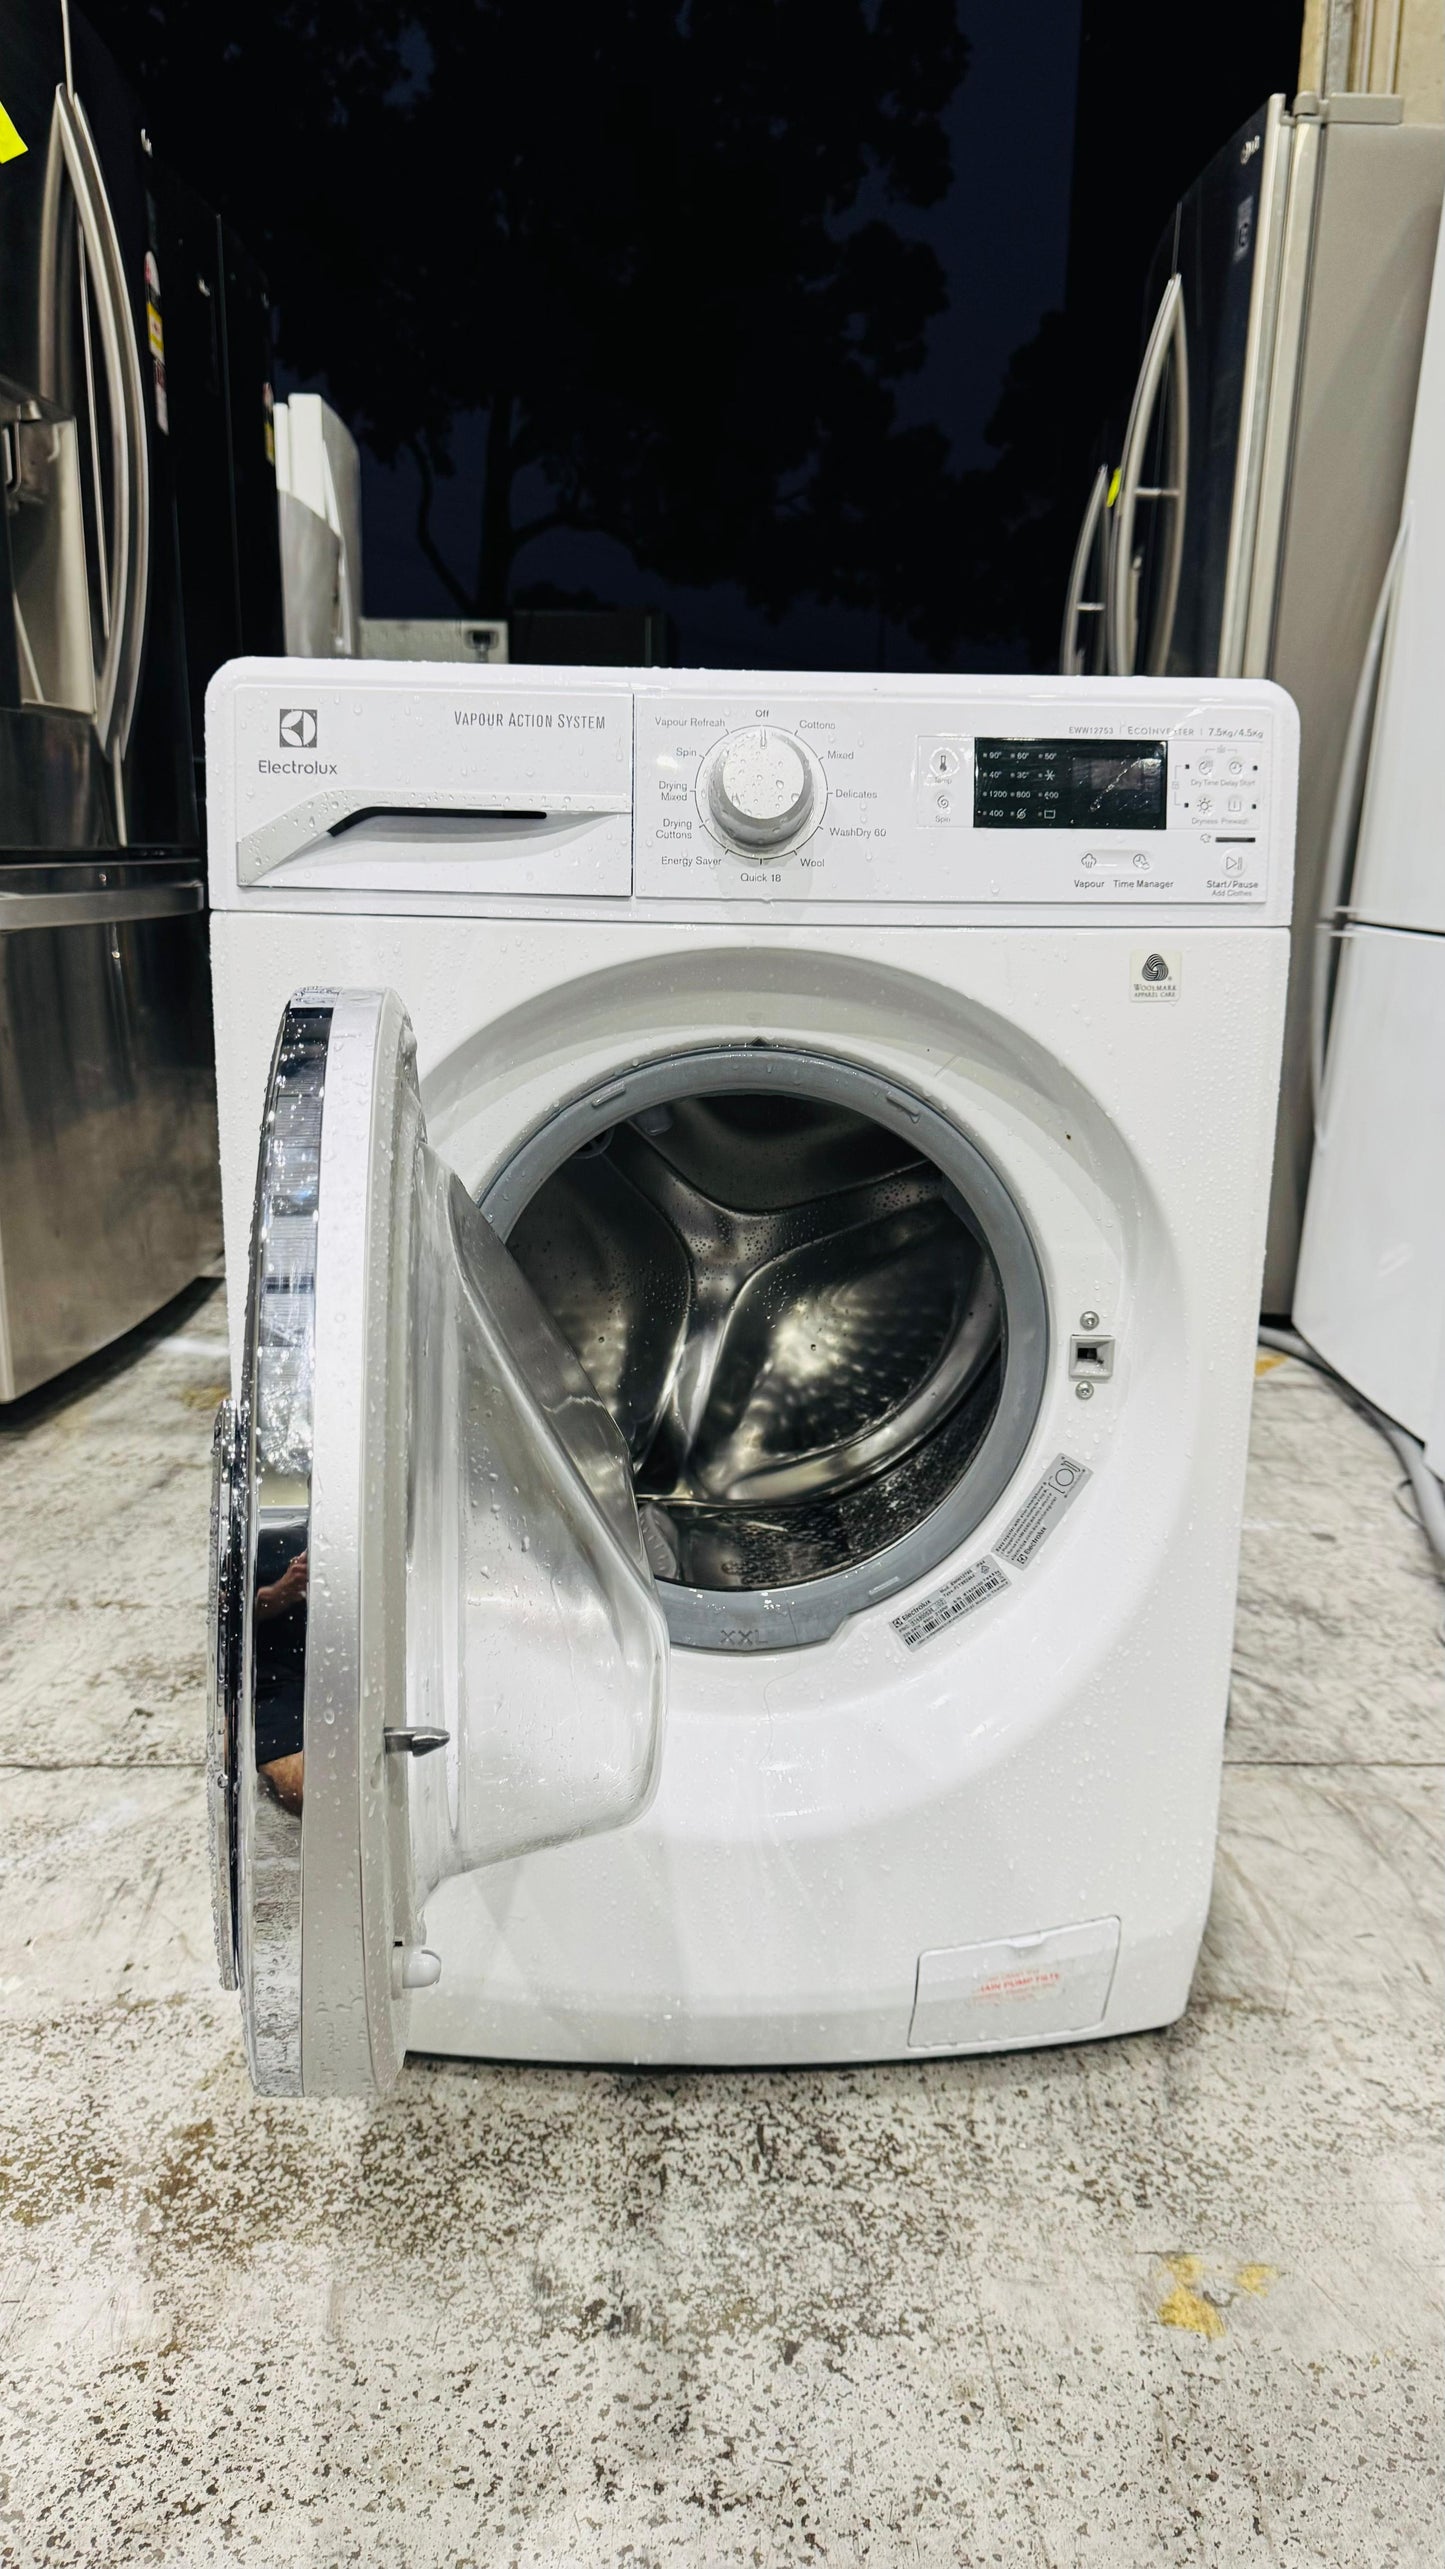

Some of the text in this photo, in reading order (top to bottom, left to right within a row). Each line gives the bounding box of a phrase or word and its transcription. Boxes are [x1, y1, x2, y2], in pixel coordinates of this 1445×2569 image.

[755, 710, 769, 718] Off
[454, 711, 606, 730] VAPOUR ACTION SYSTEM
[655, 717, 726, 728] Vapour Refresh
[799, 720, 836, 730] Cottons
[1068, 726, 1114, 735] EWW12753
[676, 748, 697, 759] Spin
[827, 751, 854, 760] Mixed
[258, 760, 338, 776] Electrolux
[658, 780, 688, 792] Drying
[661, 792, 688, 802] Mixed
[835, 789, 878, 799] Delicates
[1016, 791, 1031, 799] 800
[663, 818, 693, 830] Drying
[656, 830, 693, 840] Cottons
[830, 827, 887, 839] WashDry 60
[661, 856, 722, 867] Energy Saver
[800, 858, 825, 868] Wool
[740, 873, 781, 884] Quick 18
[1074, 880, 1105, 890] Vapour
[1113, 880, 1174, 890] Time Manager
[1206, 880, 1259, 889] Start/Pause
[1024, 1525, 1046, 1555] Electrolux
[901, 1599, 931, 1620] Electrolux
[720, 1629, 768, 1647] XXL
